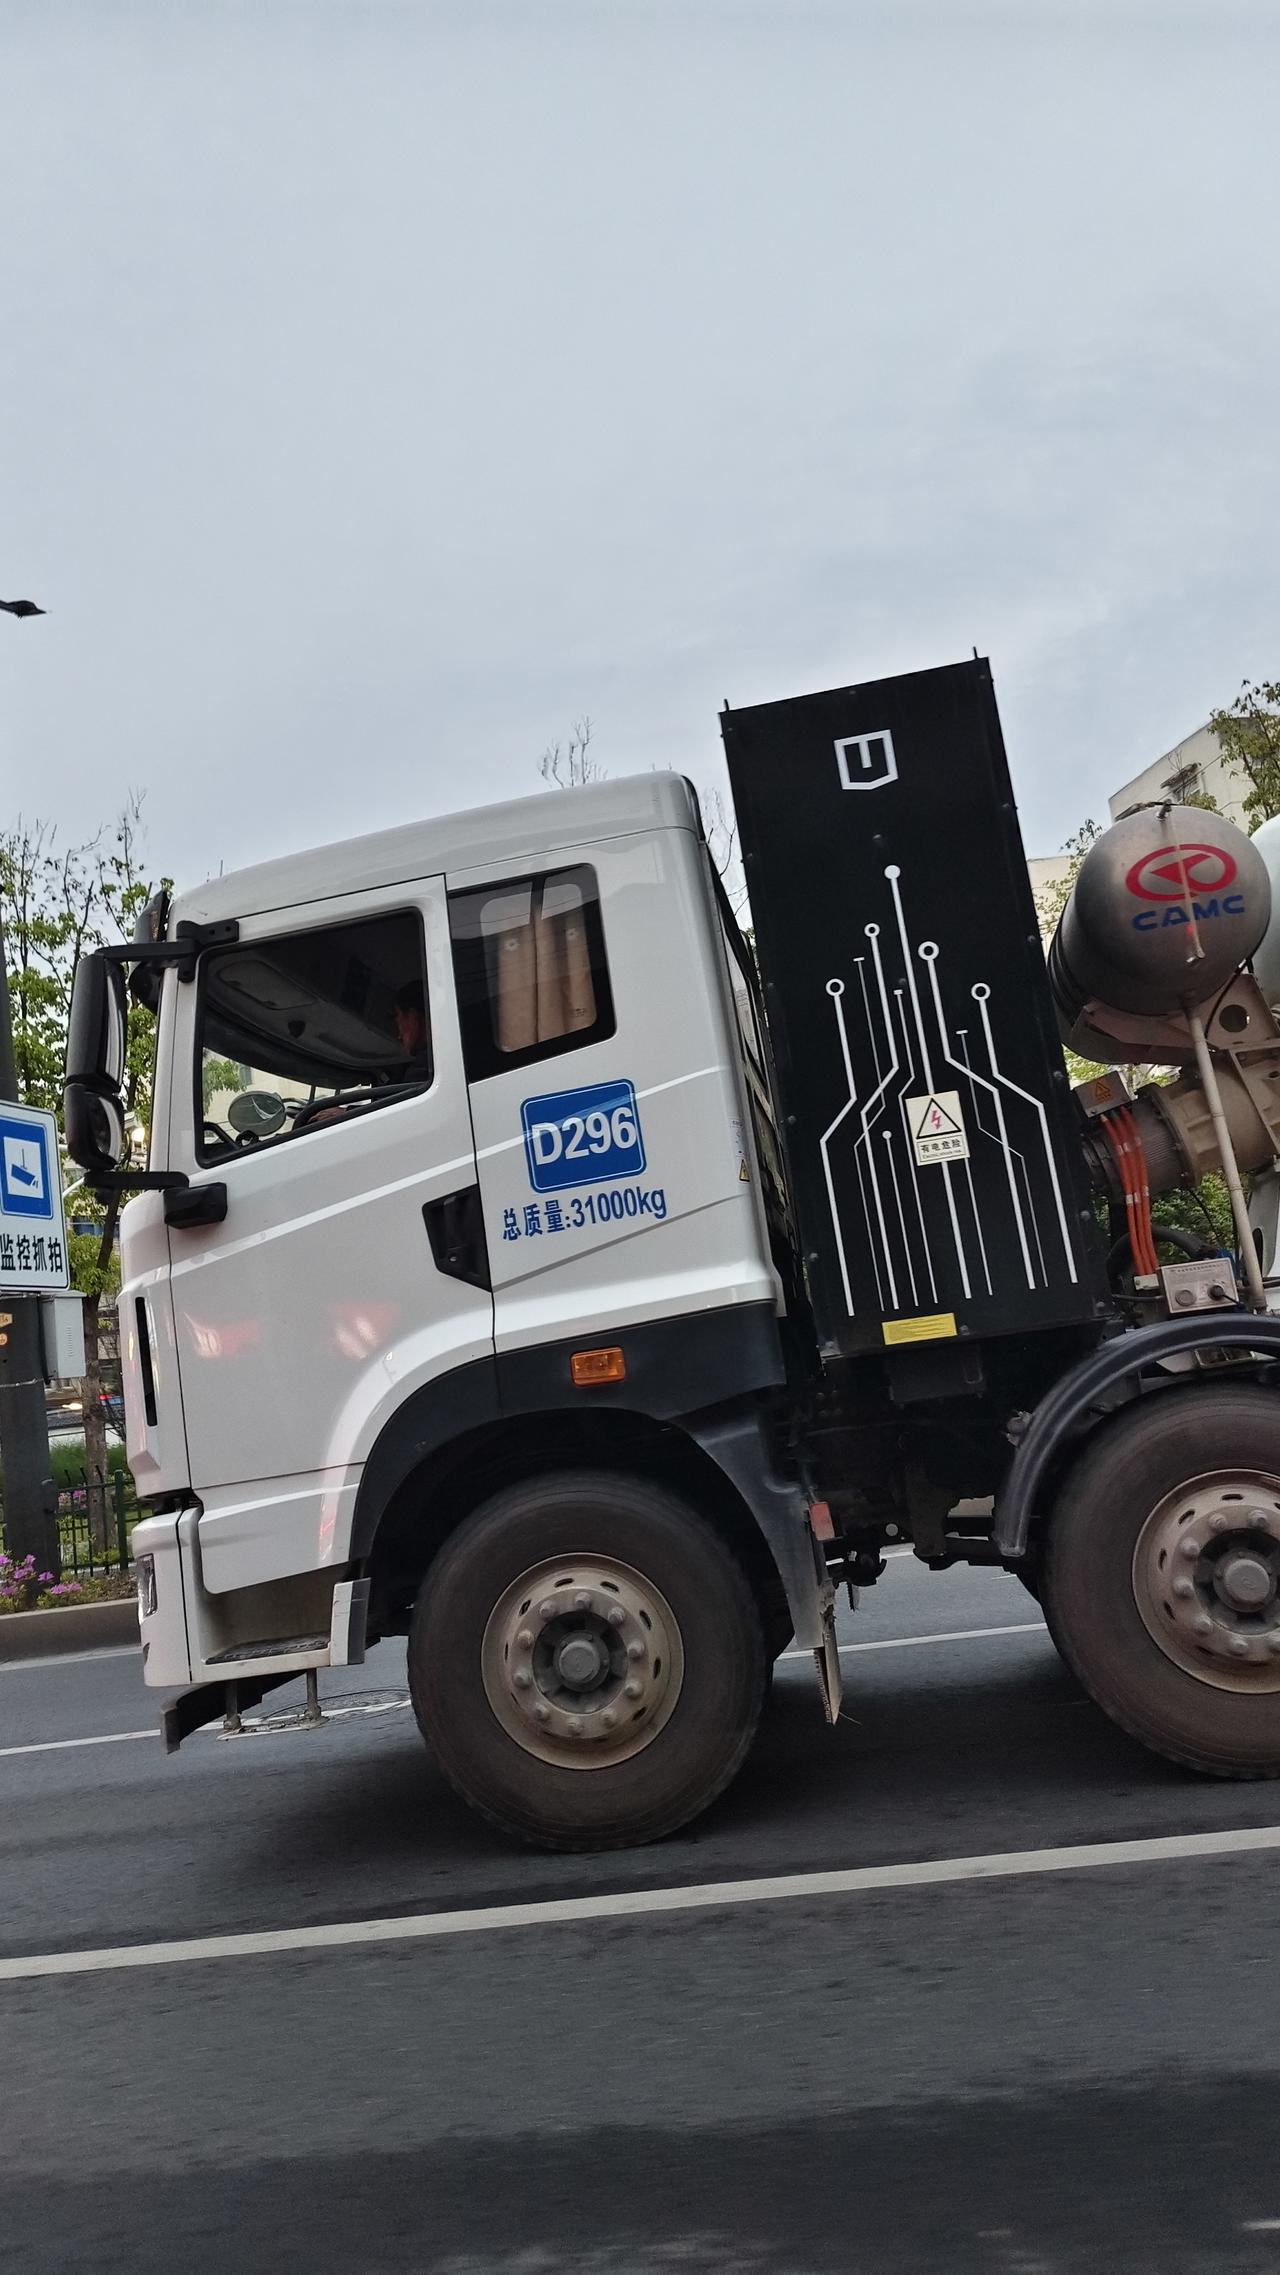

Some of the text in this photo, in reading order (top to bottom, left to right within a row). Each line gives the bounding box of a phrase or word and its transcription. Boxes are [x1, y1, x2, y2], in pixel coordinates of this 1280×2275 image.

[1132, 895, 1245, 931] CAMC
[531, 1107, 637, 1165] D296
[920, 1139, 961, 1153] 有电危险
[503, 1186, 667, 1241] 总质量:31000kg
[0, 1233, 63, 1272] 监控抓拍
